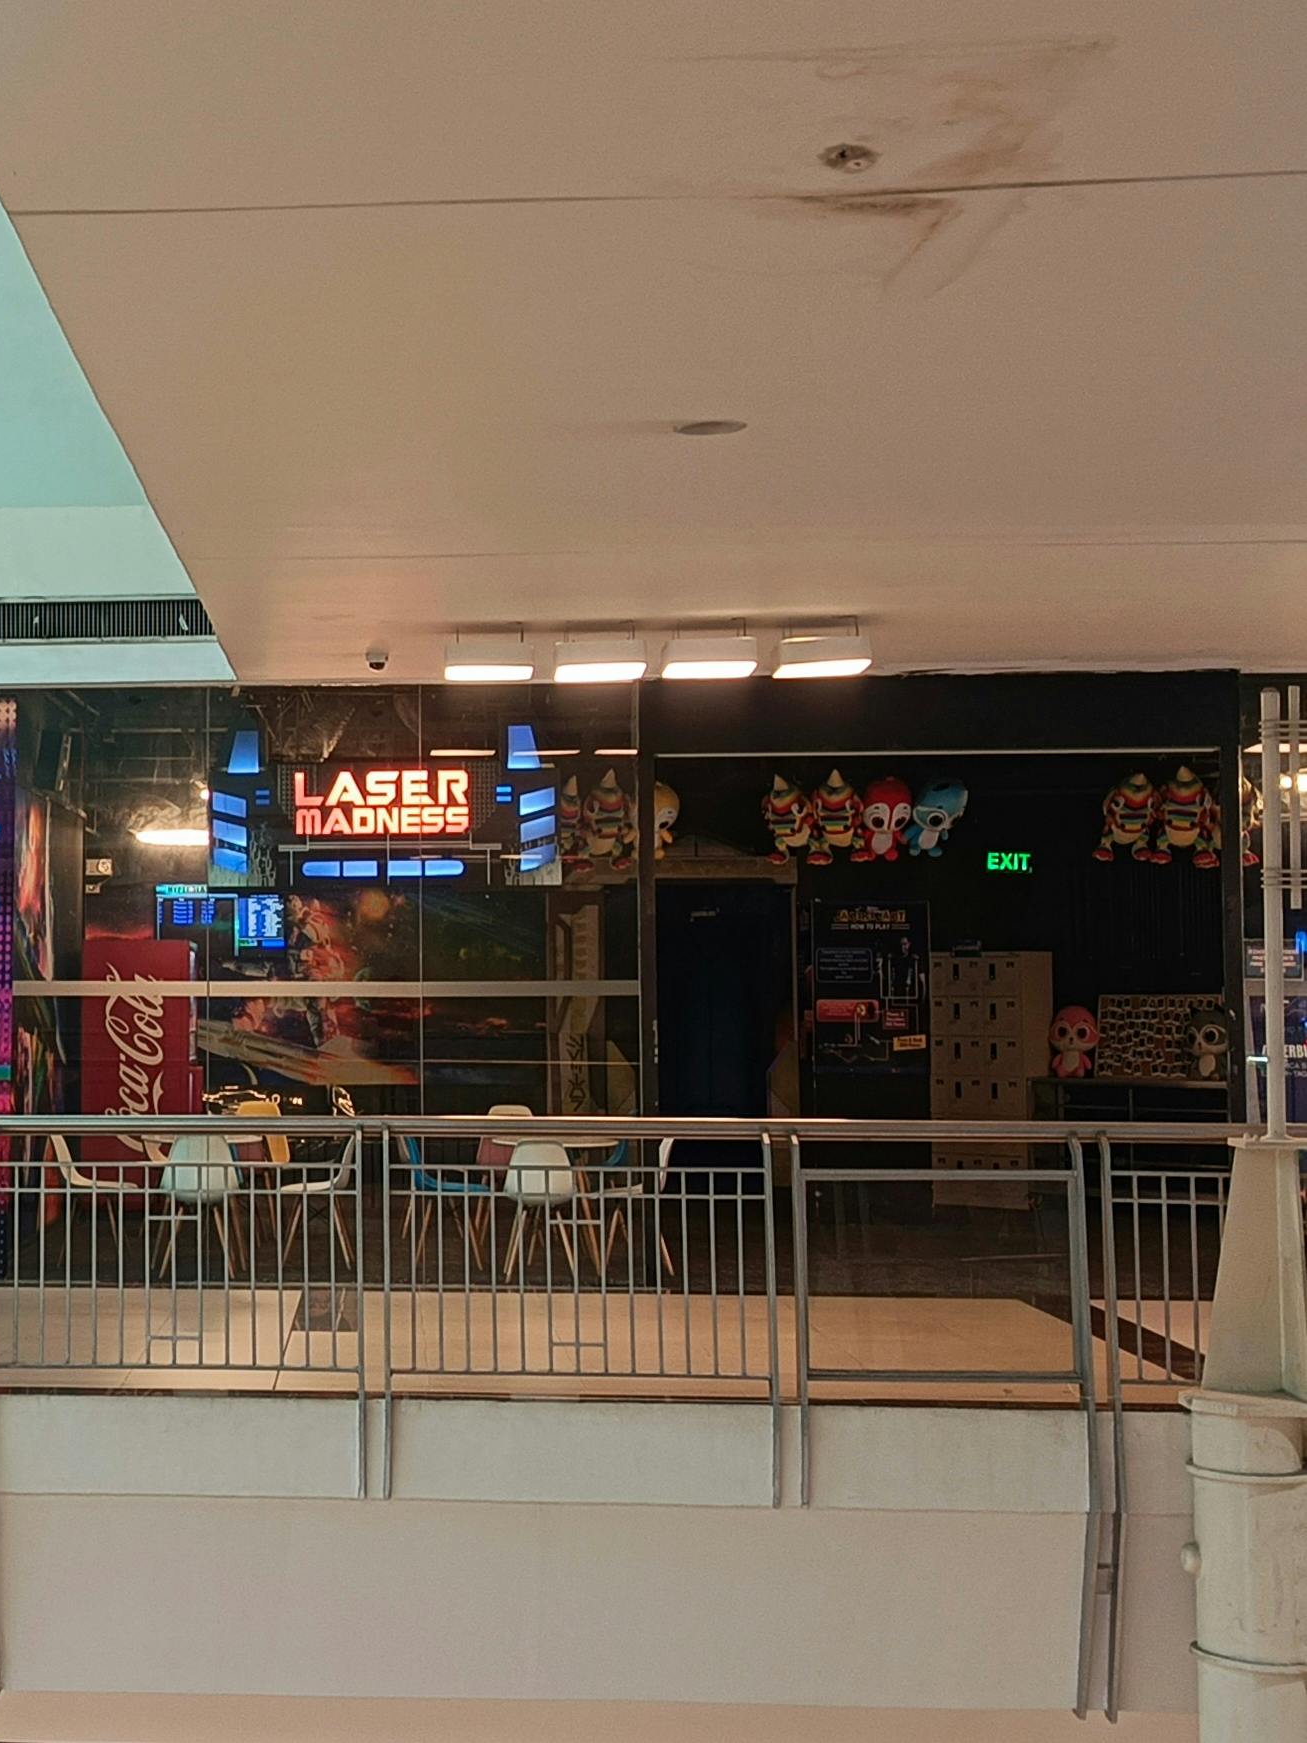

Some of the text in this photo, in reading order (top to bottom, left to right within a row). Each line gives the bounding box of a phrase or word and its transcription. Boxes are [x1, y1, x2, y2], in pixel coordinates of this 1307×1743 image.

[294, 769, 469, 807] LASER
[295, 806, 470, 836] MADNESS
[987, 852, 1031, 871] EXIT
